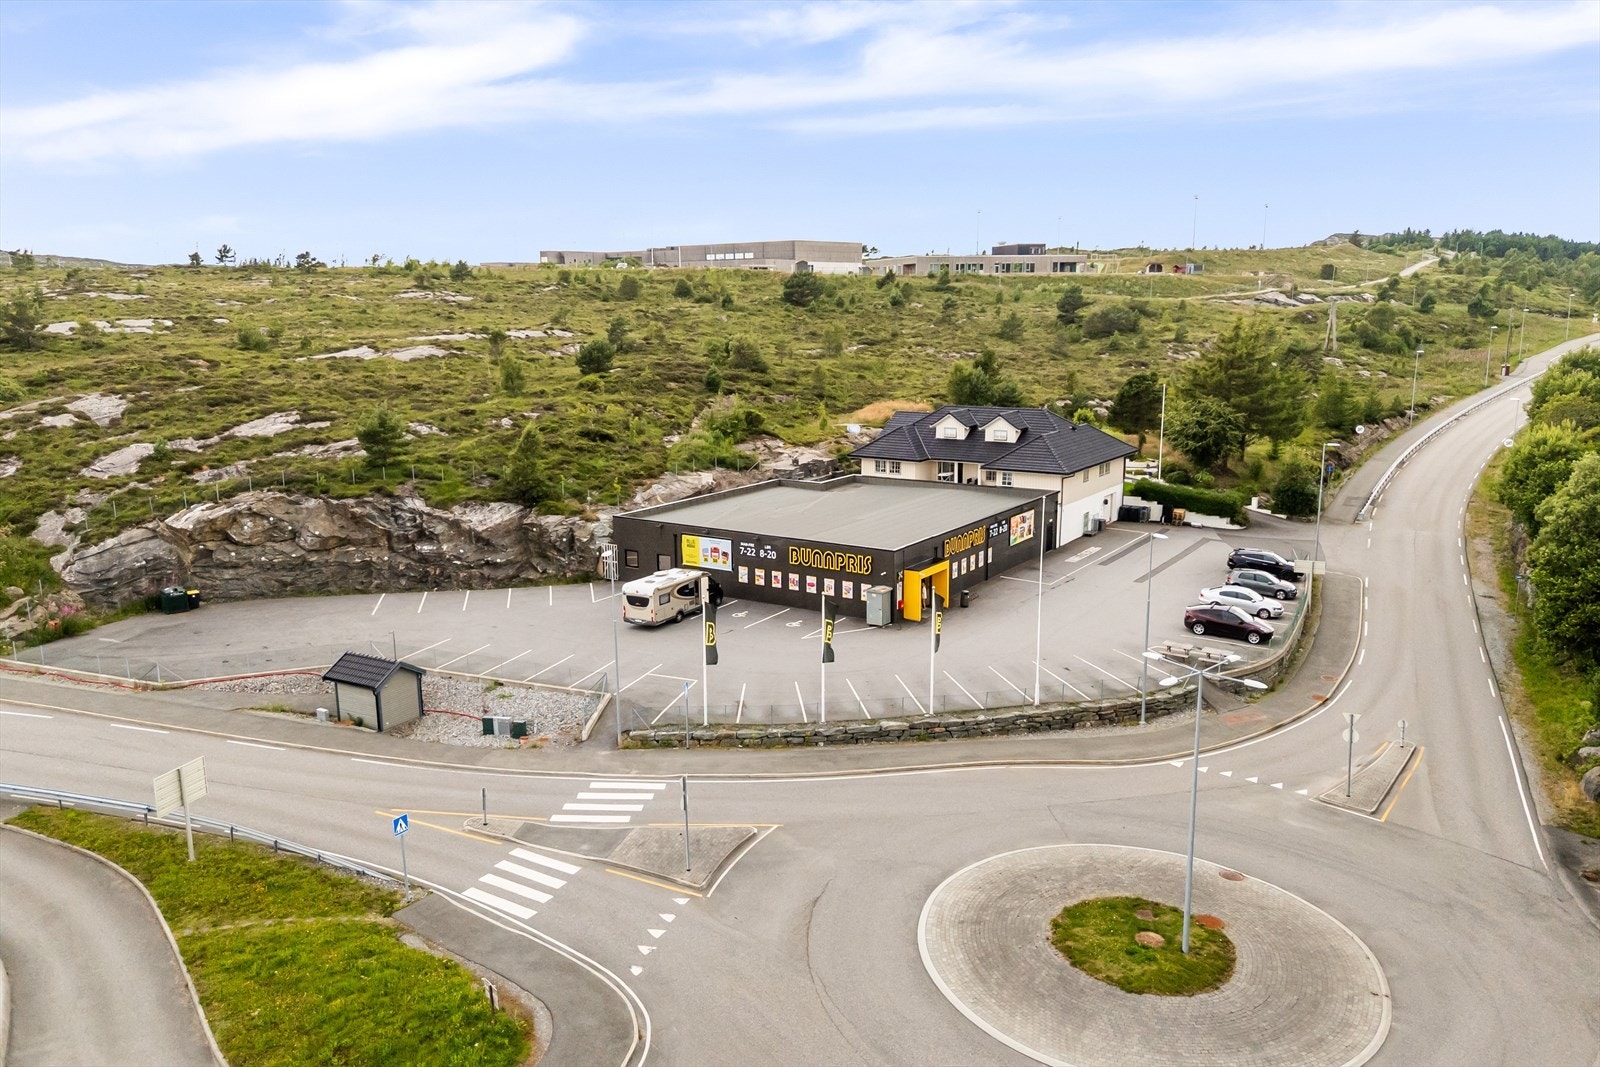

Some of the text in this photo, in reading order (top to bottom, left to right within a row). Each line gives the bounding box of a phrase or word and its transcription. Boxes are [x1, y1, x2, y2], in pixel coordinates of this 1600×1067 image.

[739, 547, 777, 560] 7-22 8-20
[944, 525, 986, 558] BUNNPRIS
[789, 546, 872, 575] BUNNPRIS
[705, 621, 717, 646] B
